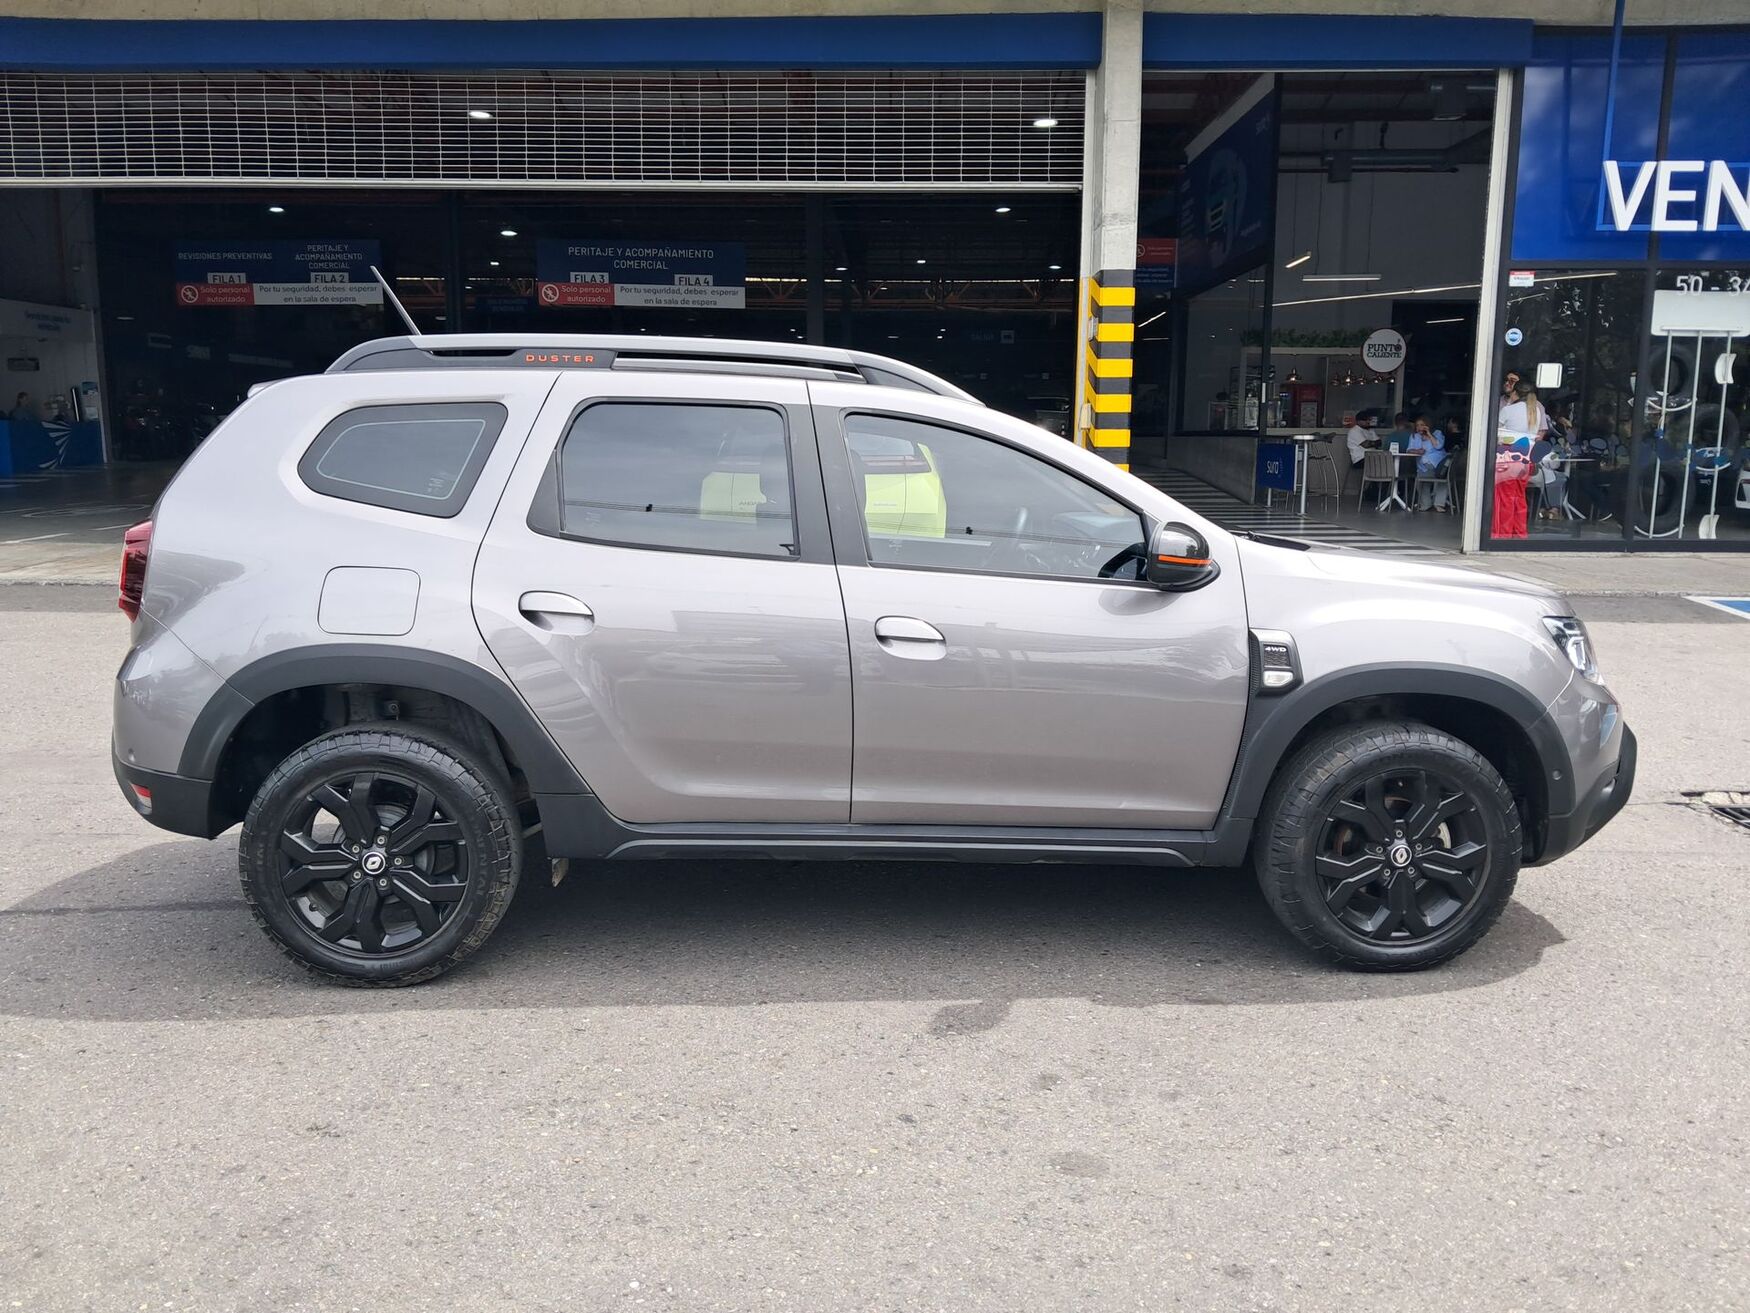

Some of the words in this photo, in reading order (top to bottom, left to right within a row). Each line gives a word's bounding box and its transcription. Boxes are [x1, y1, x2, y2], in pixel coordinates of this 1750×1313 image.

[1603, 160, 1750, 231] VEN
[178, 252, 222, 260] REVISIONES
[222, 252, 273, 260] PREVENTIVAS
[568, 246, 615, 257] PERITAJE
[616, 248, 623, 257] Y
[625, 246, 714, 259] ACOMPAÑAMIENTO
[613, 260, 669, 270] COMERCIAL
[212, 274, 236, 284] FILA
[237, 274, 242, 284] 1
[314, 274, 337, 283] FILA
[339, 274, 346, 283] 2
[574, 274, 597, 283] FILA
[598, 274, 605, 283] 3
[678, 276, 702, 286] FILA
[703, 277, 710, 286] 4
[259, 285, 271, 293] Por
[349, 286, 377, 294] esperar
[561, 285, 578, 293] Solo
[579, 286, 611, 295] personal
[1676, 275, 1704, 296] 50
[218, 286, 250, 295] personal
[620, 286, 633, 294] Por
[711, 289, 739, 297] esperar
[664, 297, 680, 305] sala
[1367, 343, 1403, 352] PUNTO
[525, 354, 595, 363] DUSTER
